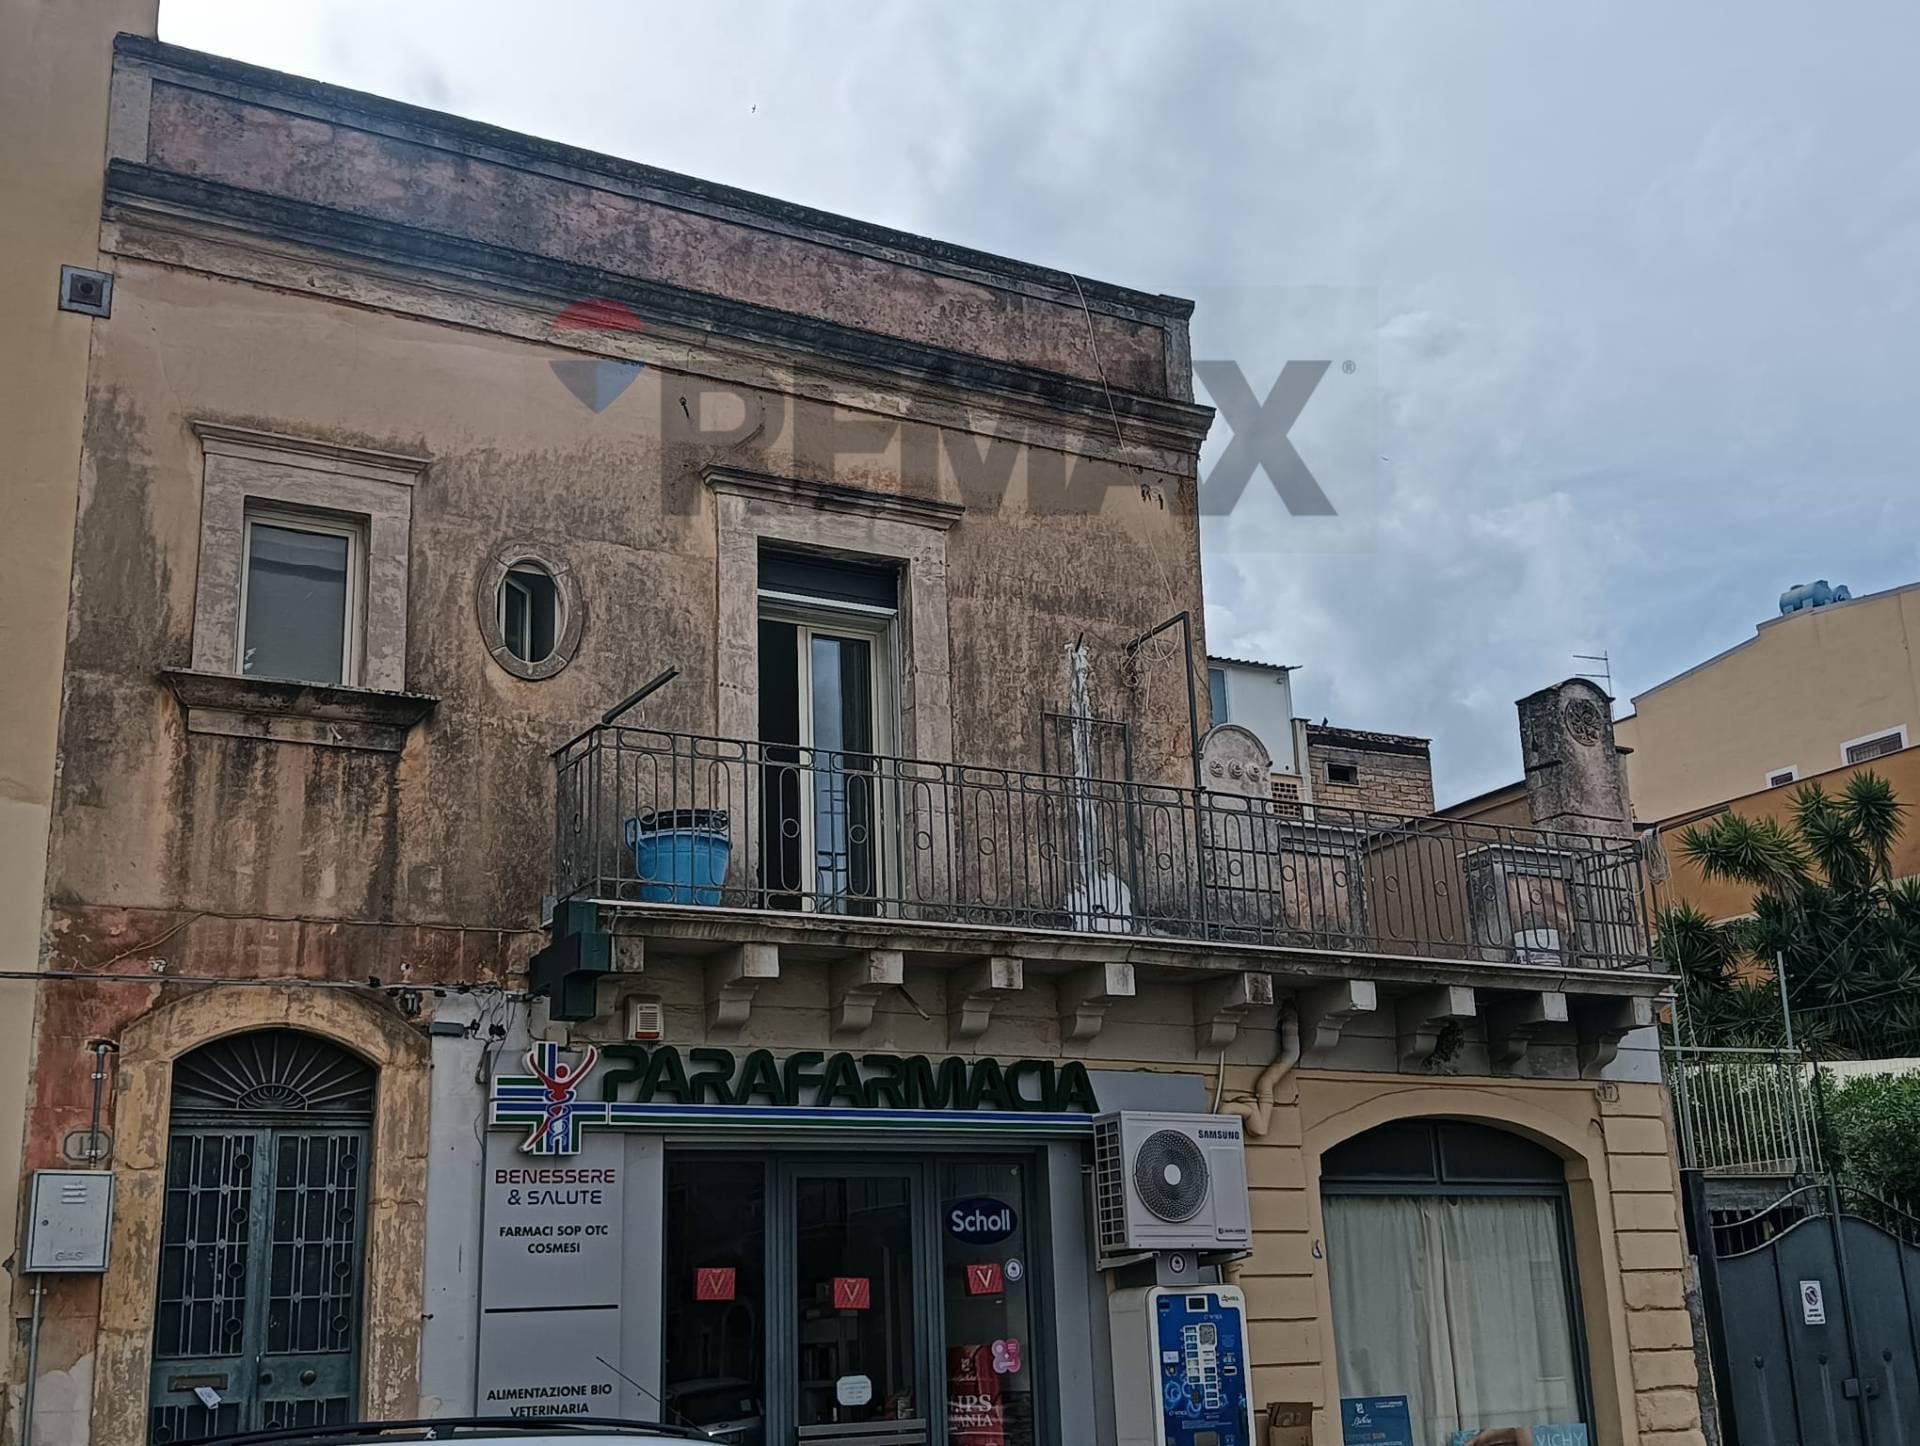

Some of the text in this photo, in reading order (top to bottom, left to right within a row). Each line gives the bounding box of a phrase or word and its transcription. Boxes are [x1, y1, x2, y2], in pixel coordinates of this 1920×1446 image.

[601, 1045, 1101, 1113] PARAFARMACIA
[1198, 1130, 1240, 1140] SAMSUNG
[495, 1169, 616, 1184] BENESSERE
[507, 1189, 602, 1205] & SALUTE
[951, 1209, 1011, 1233] Scholl
[499, 1225, 609, 1237] FARMACI SOP OTC
[527, 1242, 581, 1254] COSMESI
[486, 1383, 613, 1401] ALIMENTAZIONE BIO
[510, 1402, 590, 1418] VETERINARIA
[1535, 1431, 1584, 1446] VICHY
